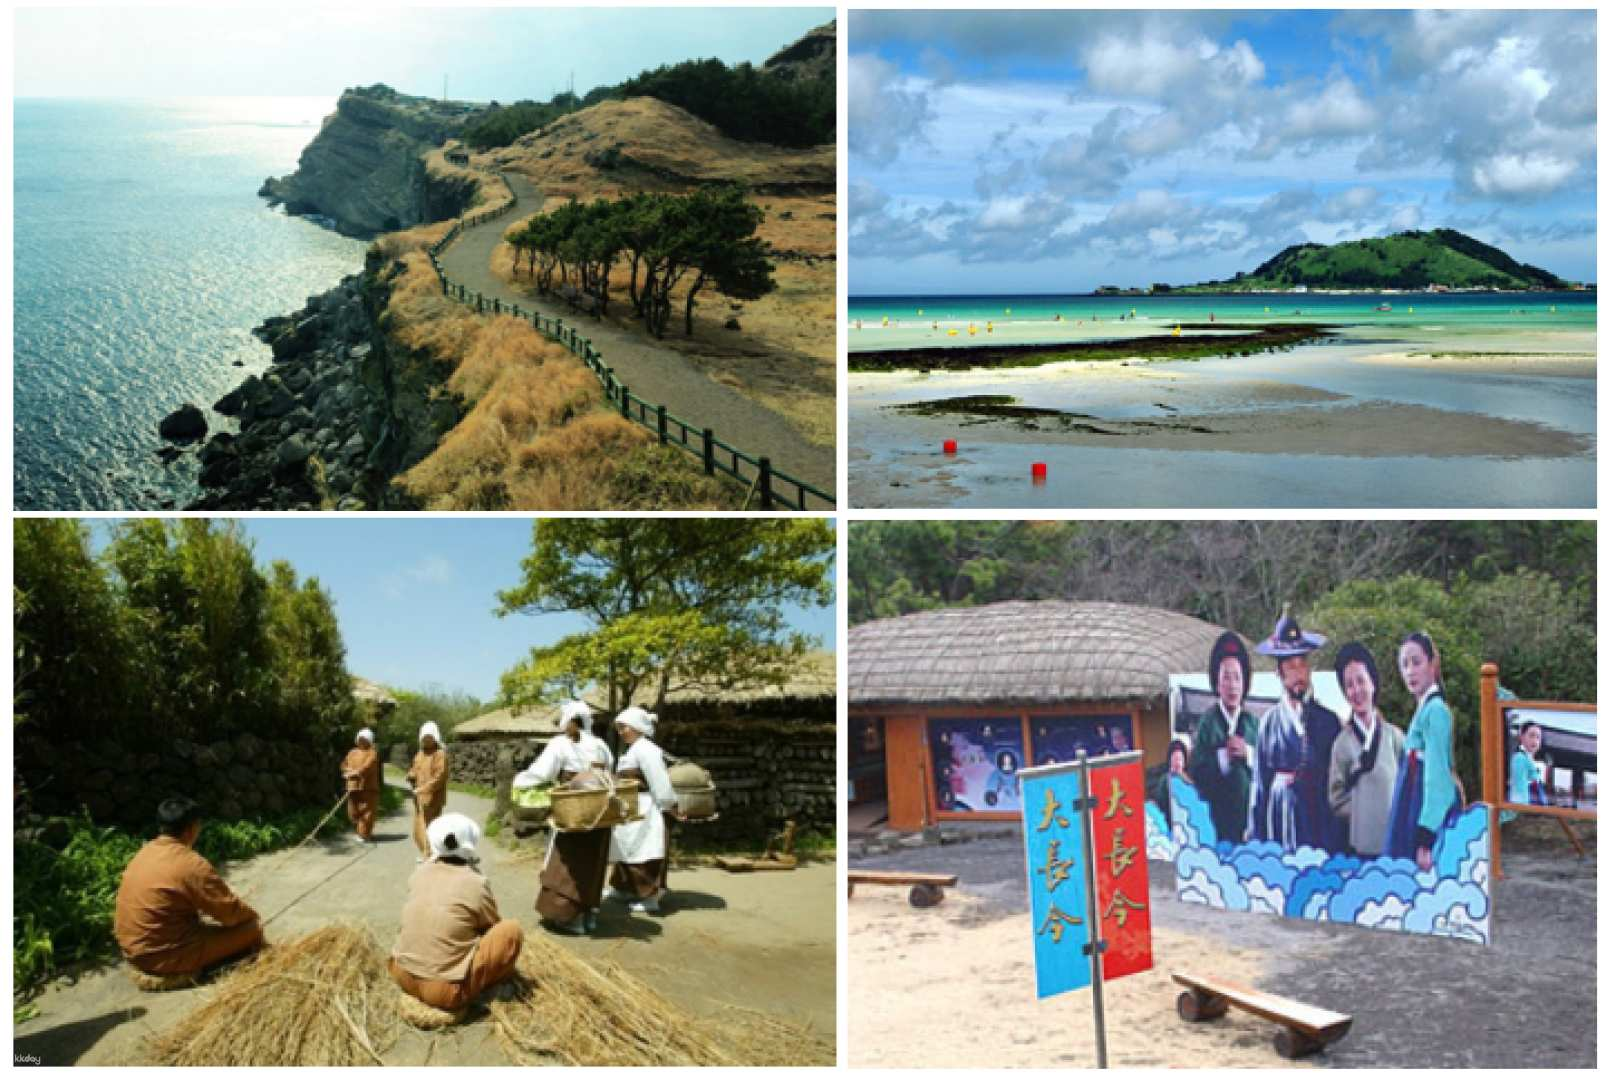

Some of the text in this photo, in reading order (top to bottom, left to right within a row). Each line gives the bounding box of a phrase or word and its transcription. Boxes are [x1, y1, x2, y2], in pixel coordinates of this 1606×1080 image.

[1037, 788, 1083, 942] 大長今
[1103, 777, 1145, 927] 大長今
